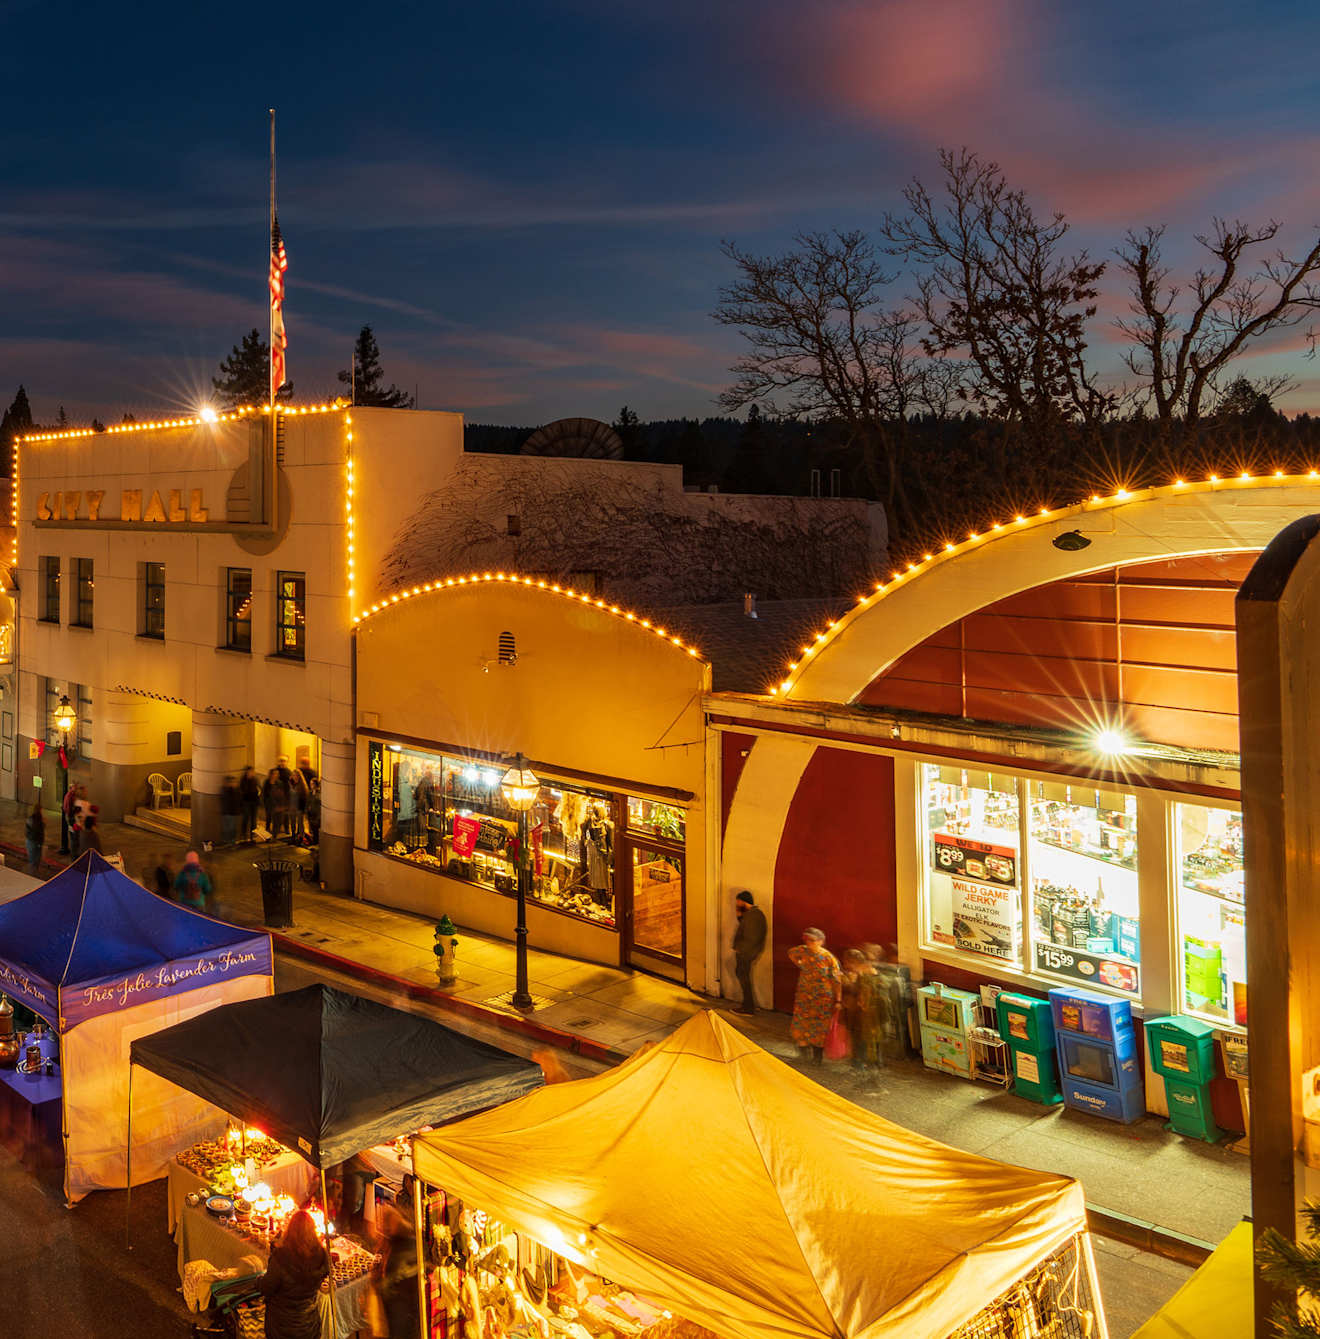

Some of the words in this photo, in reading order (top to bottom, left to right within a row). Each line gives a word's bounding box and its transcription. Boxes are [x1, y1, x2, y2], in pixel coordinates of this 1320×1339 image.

[37, 490, 106, 521] CITY
[120, 488, 209, 523] HALL
[371, 751, 382, 840] INDUSTRIAL
[953, 882, 977, 894] WILD
[980, 887, 1009, 902] GAME
[964, 893, 997, 907] JERKY
[962, 903, 1000, 916] ALLIGATOR
[958, 938, 982, 951] SOLD
[983, 945, 1009, 957] HERE
[83, 987, 113, 1006] Très
[117, 973, 153, 1006] Jolie
[156, 959, 217, 988] Lavender
[219, 951, 256, 972] Farm
